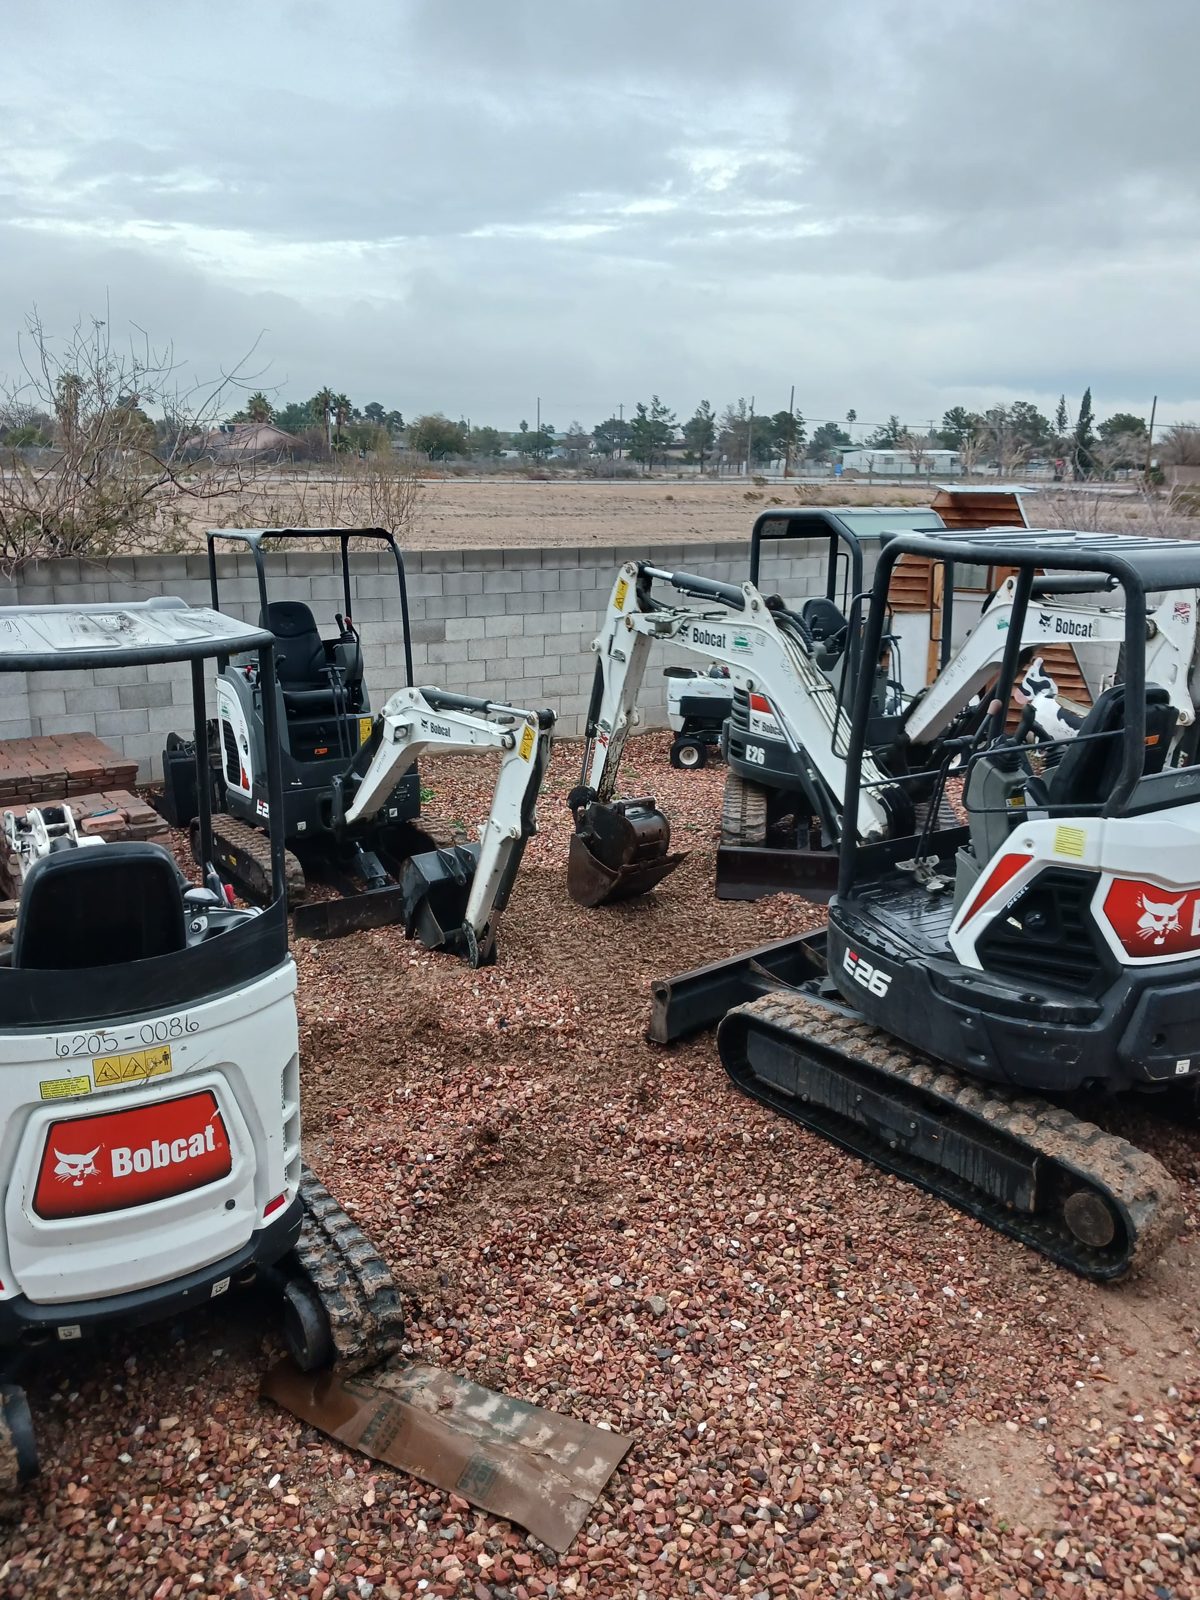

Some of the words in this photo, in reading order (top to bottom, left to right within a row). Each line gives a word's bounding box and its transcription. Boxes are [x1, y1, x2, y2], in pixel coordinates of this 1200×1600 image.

[692, 627, 727, 649] Bobcat
[1055, 617, 1093, 638] Bobcat
[430, 722, 452, 738] Bobcat
[761, 721, 784, 736] Bobca
[745, 744, 766, 765] E26
[255, 799, 270, 819] E2
[842, 947, 893, 998] E26
[55, 1014, 200, 1057] 6205-0086
[110, 1124, 216, 1178] Bobcat
